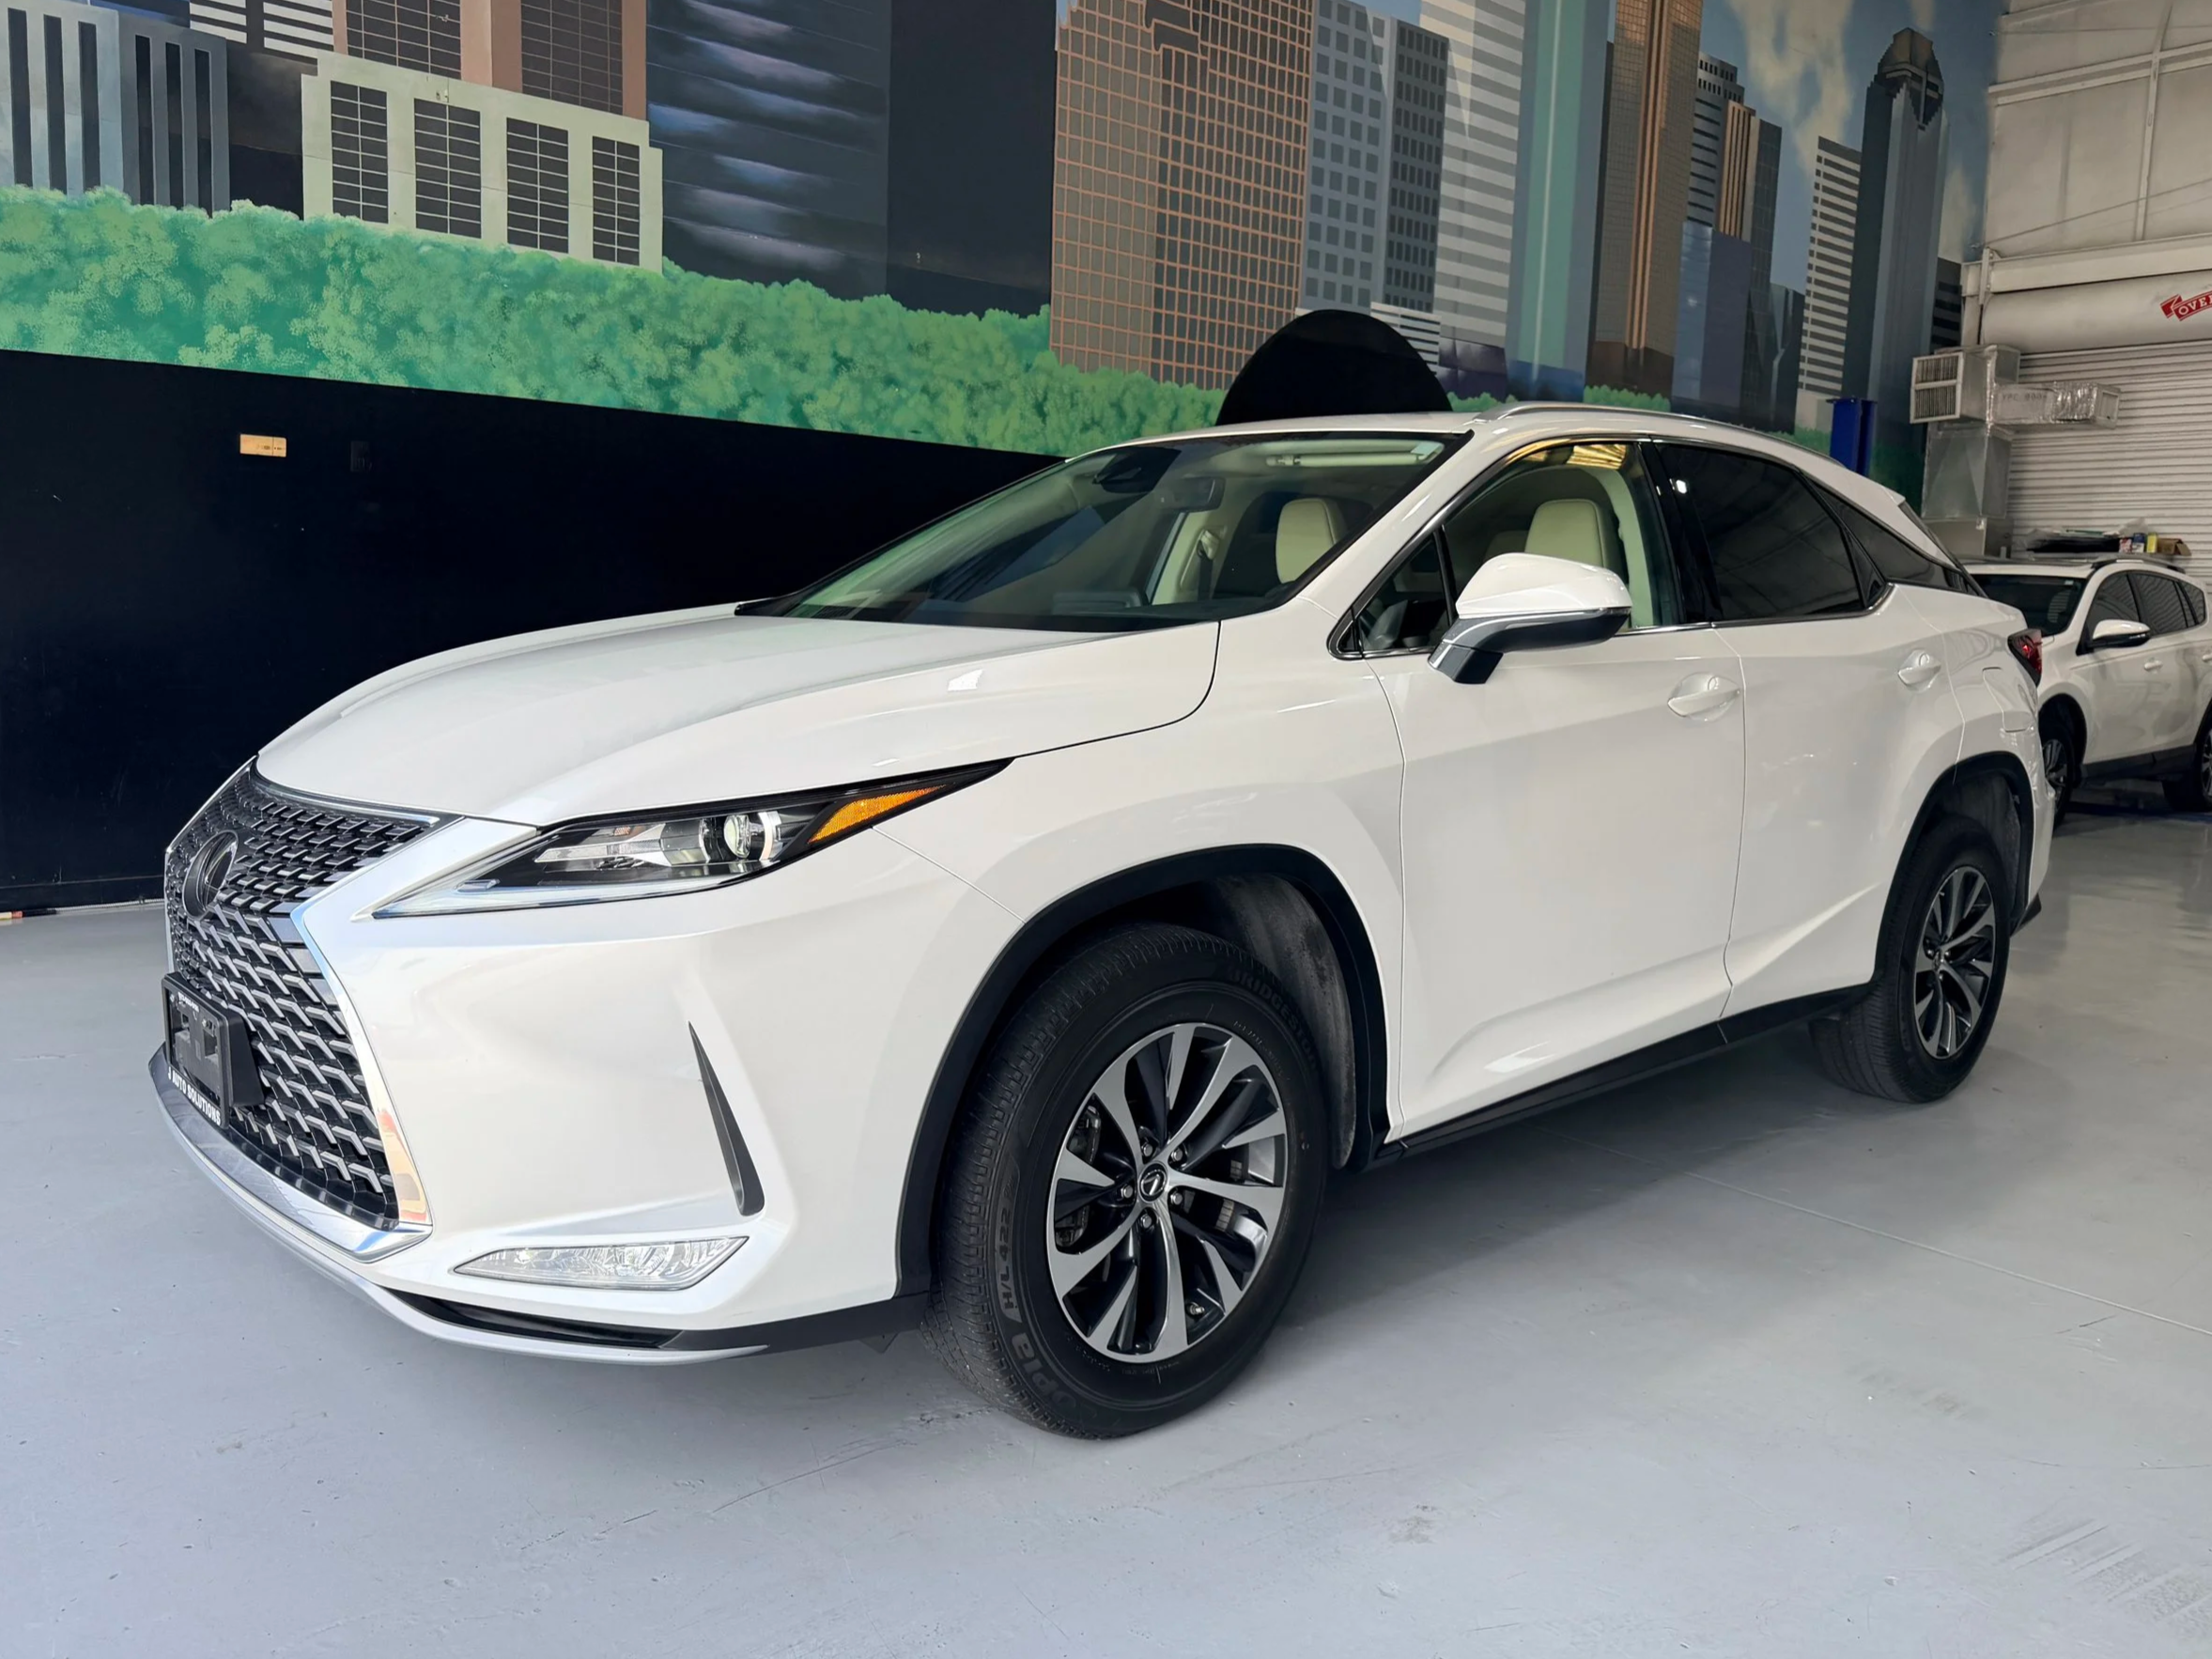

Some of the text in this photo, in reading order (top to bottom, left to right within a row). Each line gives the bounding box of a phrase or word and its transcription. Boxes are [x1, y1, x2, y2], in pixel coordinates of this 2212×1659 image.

[1227, 966, 1318, 1071] BRIDGESTON
[167, 1065, 222, 1126] J AUTO SOLUTIONS
[998, 1207, 1012, 1263] 422
[999, 1265, 1015, 1310] H/L
